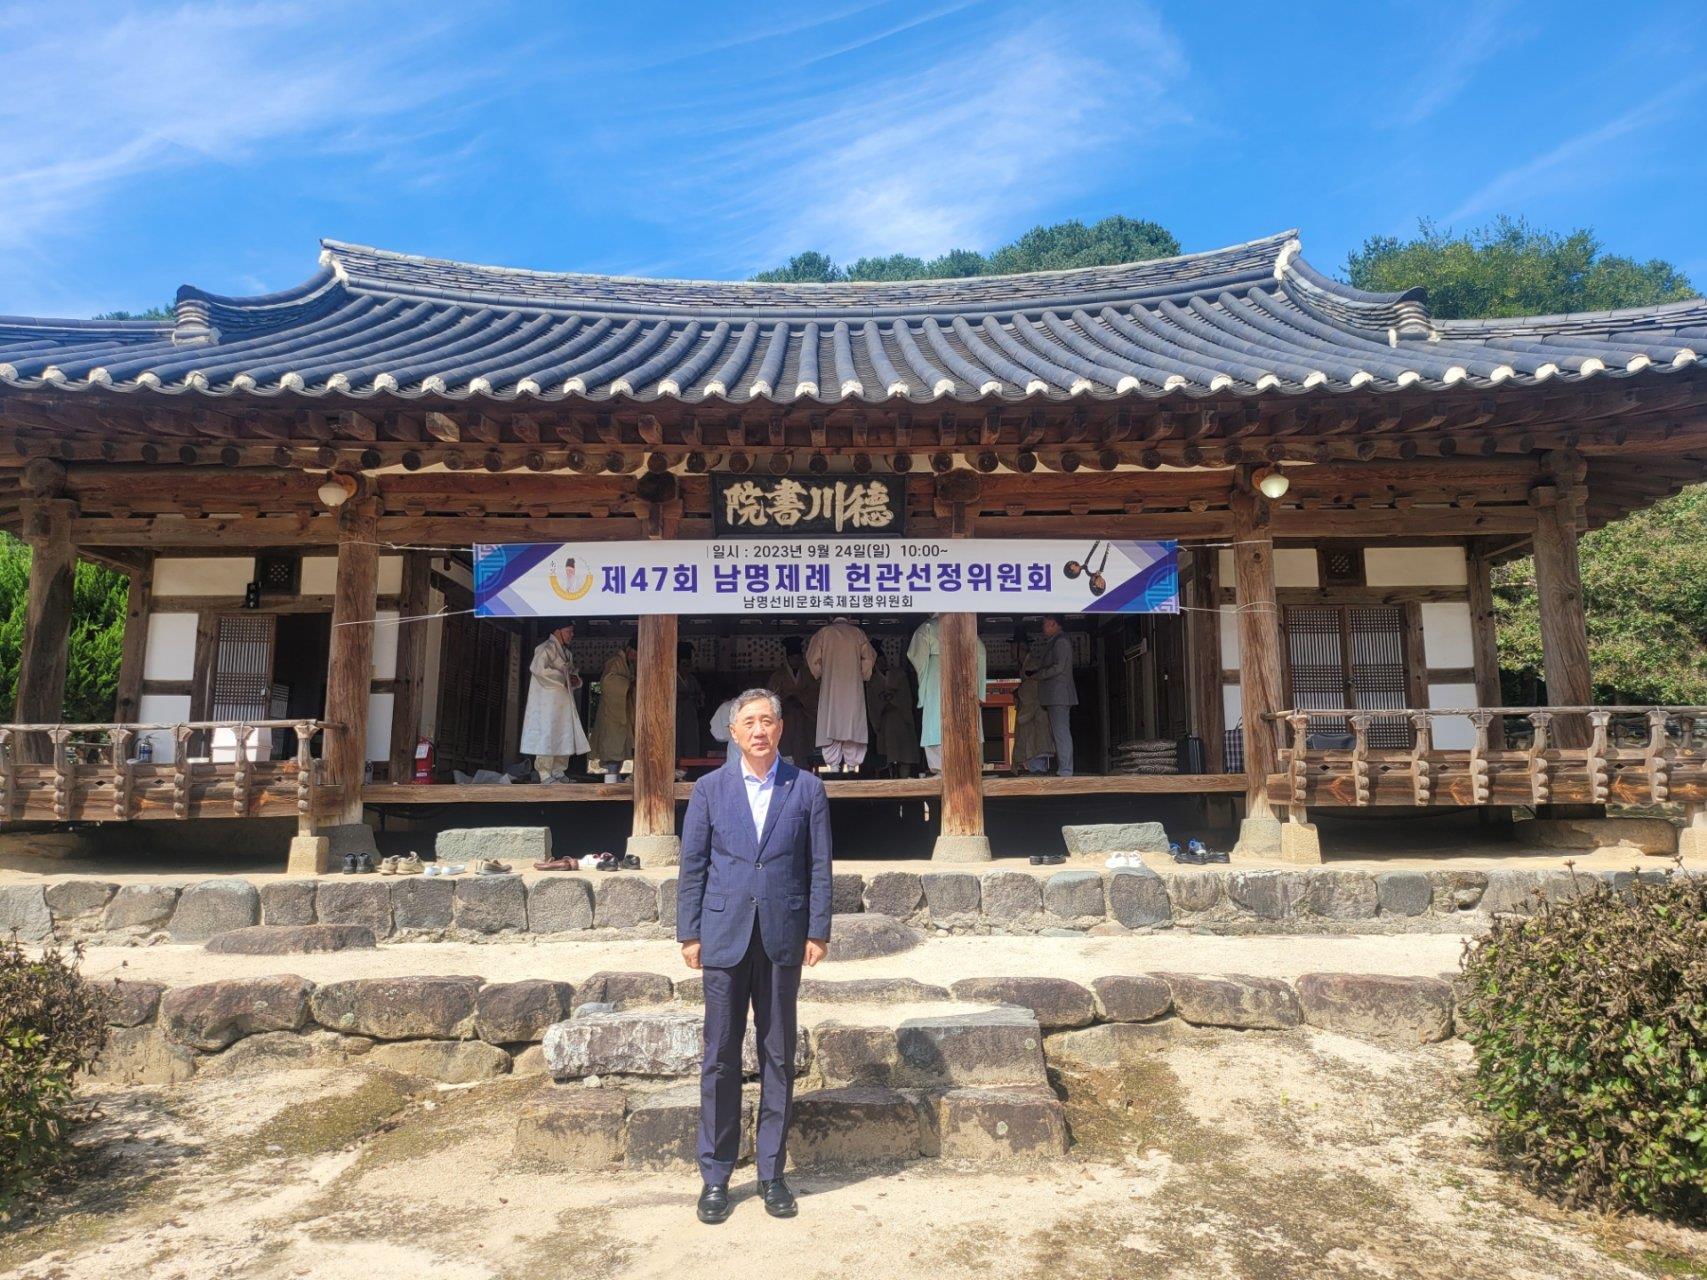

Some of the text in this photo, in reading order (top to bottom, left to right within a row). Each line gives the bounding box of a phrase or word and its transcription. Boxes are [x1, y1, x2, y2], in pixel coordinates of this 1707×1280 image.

[713, 544, 739, 559] 일시
[753, 544, 802, 559] 2023년
[808, 544, 829, 559] 9월
[835, 543, 891, 559] 24일(일)
[900, 544, 948, 557] 10:00~
[601, 562, 1052, 594] 제47회 남명제례 헌관선정위원회
[743, 595, 913, 609] 남명선비문화축제집행위원회
